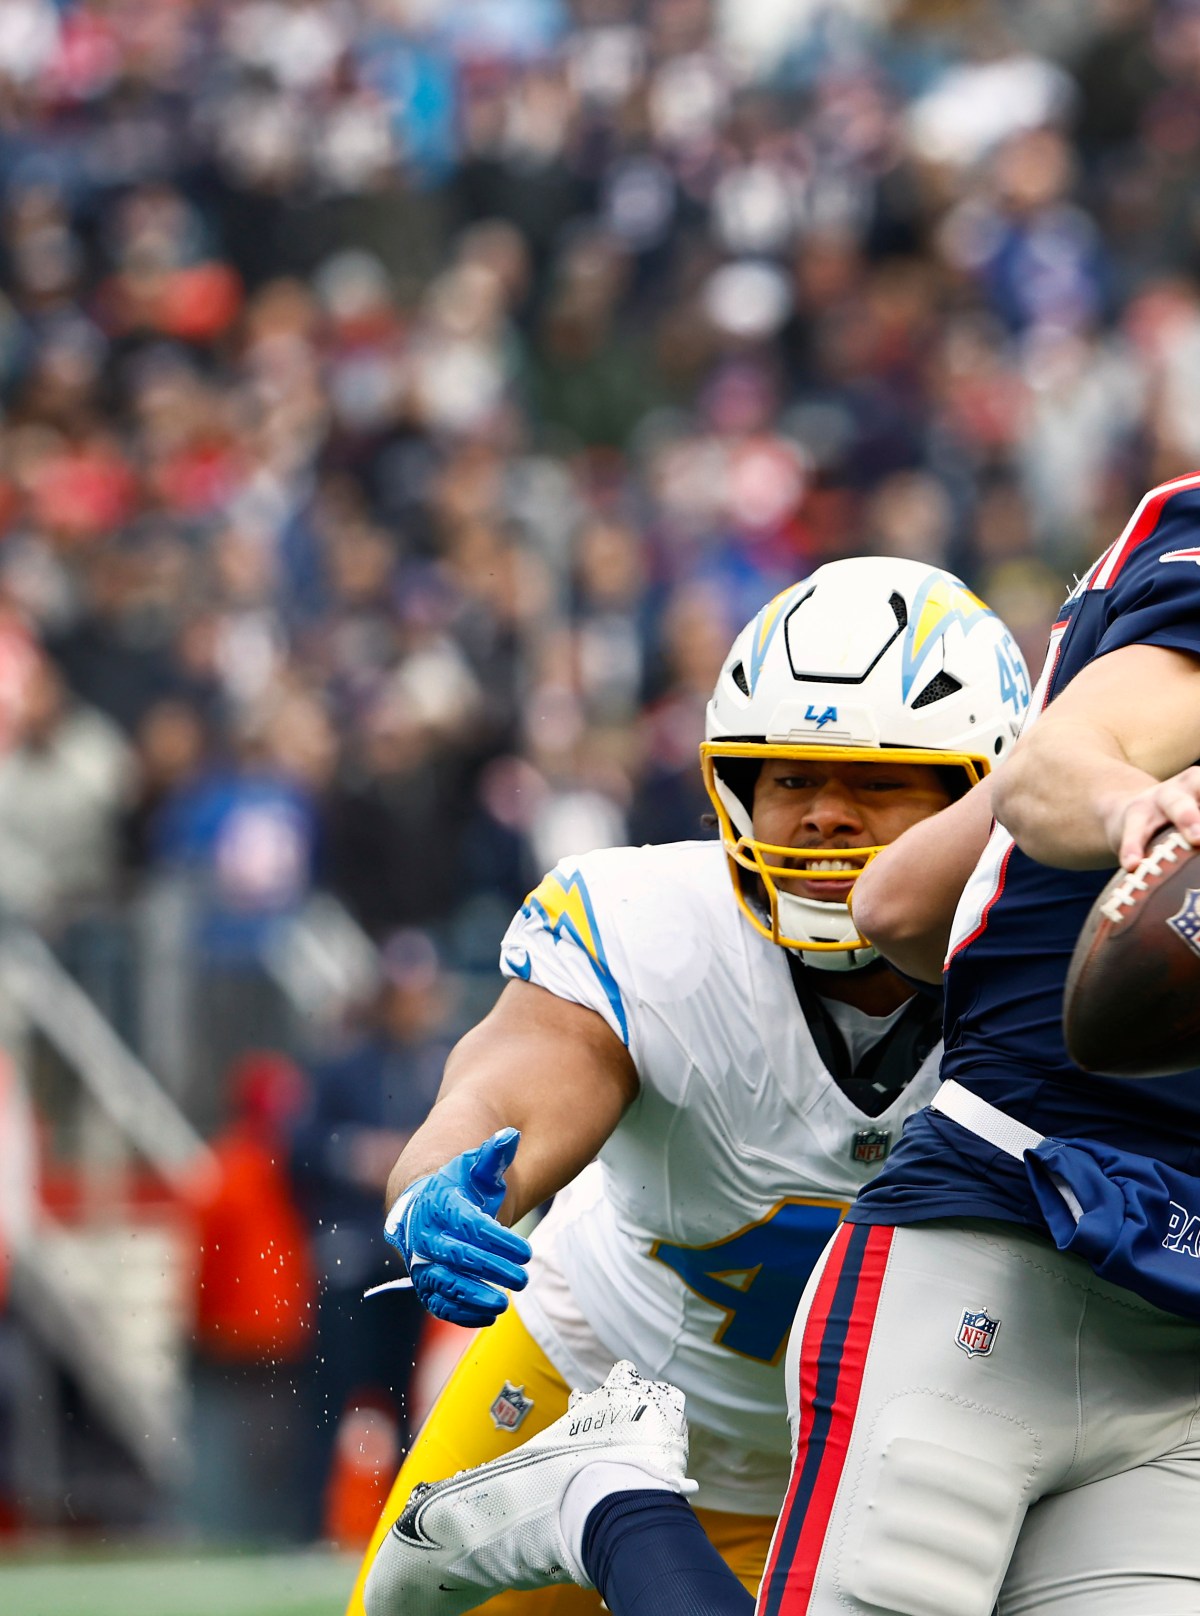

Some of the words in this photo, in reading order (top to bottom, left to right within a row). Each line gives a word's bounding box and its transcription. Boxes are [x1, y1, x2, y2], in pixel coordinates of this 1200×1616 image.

[994, 634, 1030, 715] 45
[804, 705, 837, 730] LA
[857, 1144, 883, 1160] NFL
[961, 1326, 989, 1349] NFL
[495, 1400, 517, 1425] NFL
[569, 1408, 632, 1436] VAPOR
